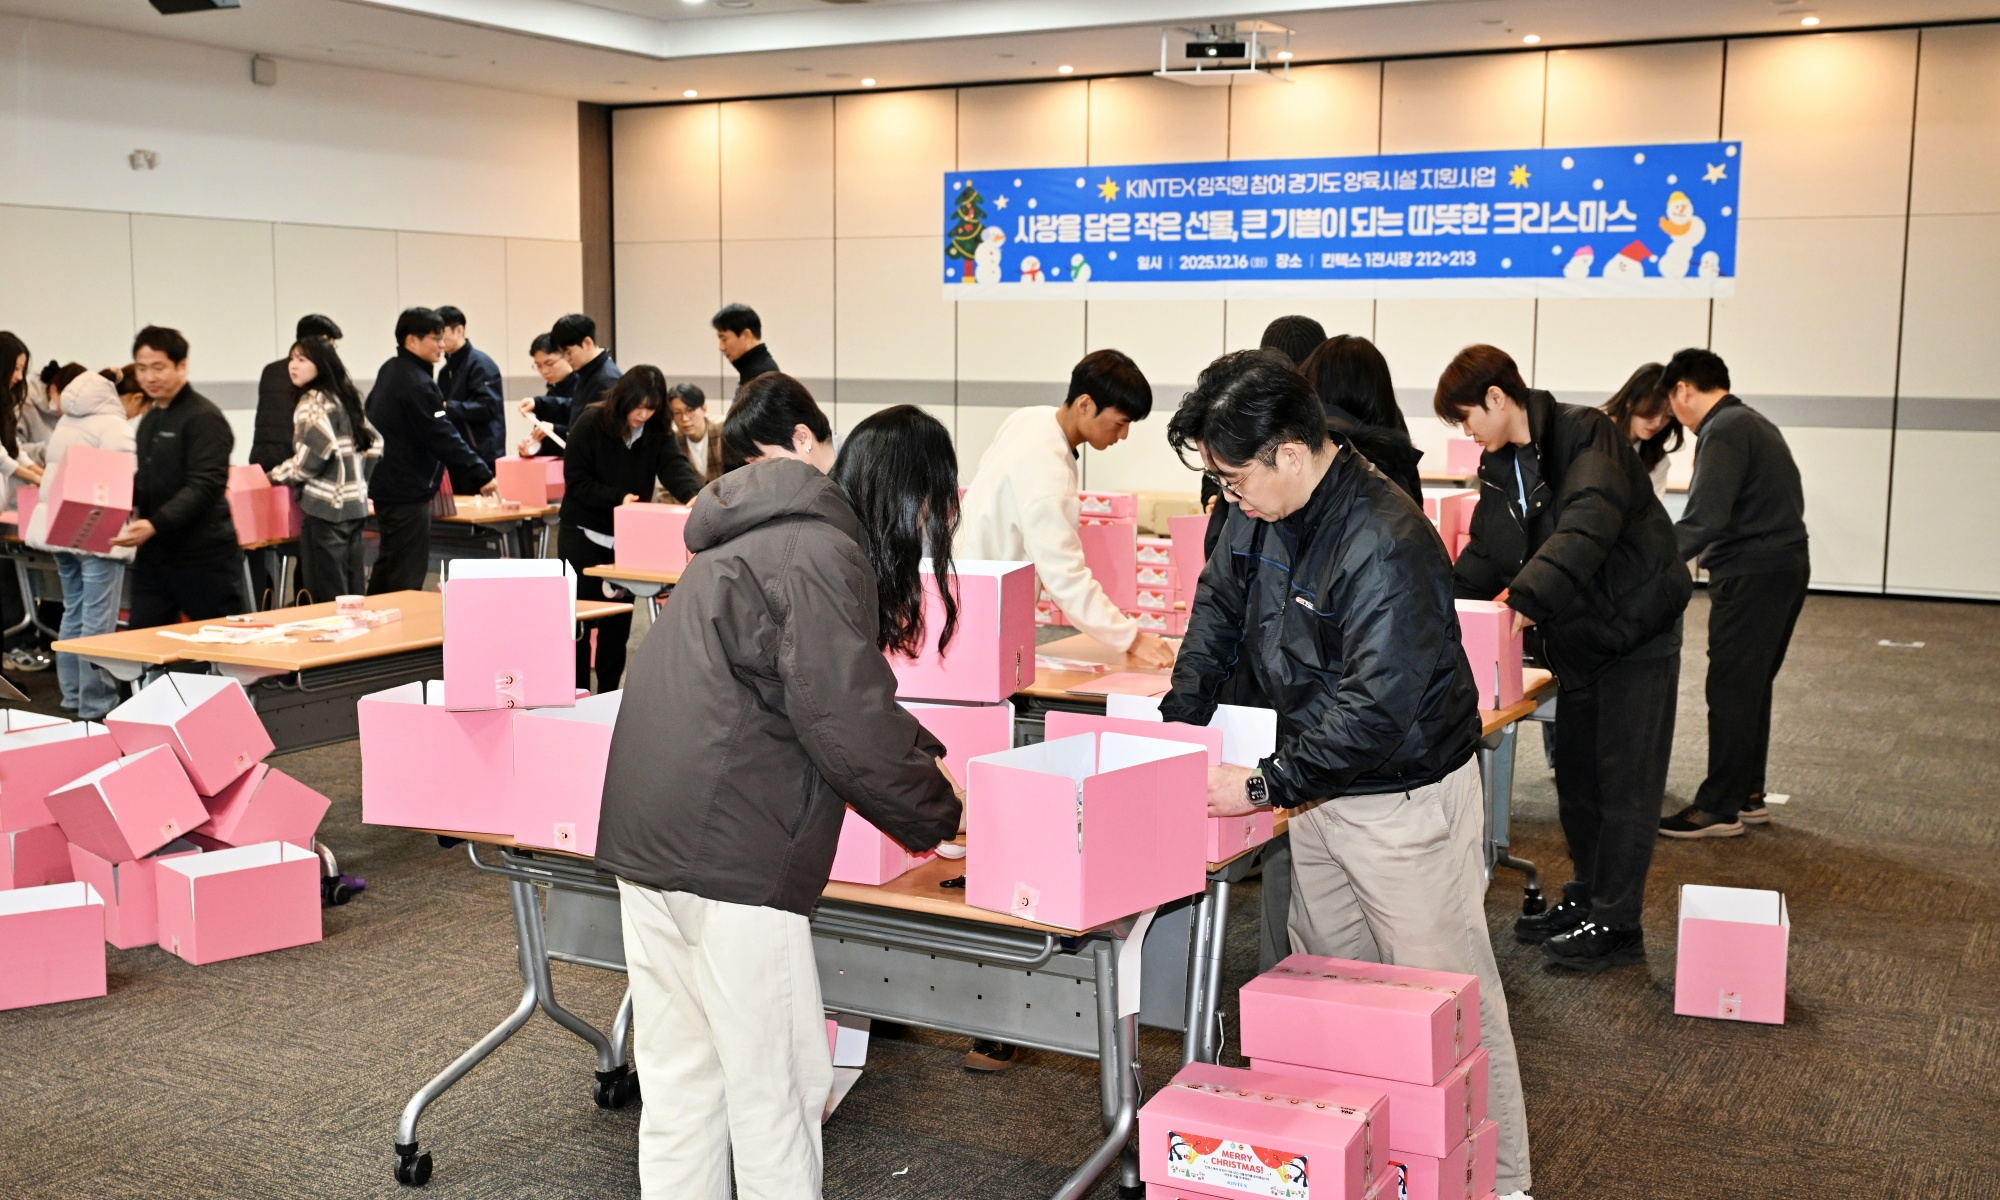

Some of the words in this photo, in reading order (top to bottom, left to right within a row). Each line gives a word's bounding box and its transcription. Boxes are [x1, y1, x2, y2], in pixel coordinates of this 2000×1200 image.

[1126, 178, 1195, 199] KINTEX
[1197, 176, 1248, 197] 임직원
[1251, 174, 1286, 195] 참여
[1288, 172, 1341, 194] 경기도
[1344, 170, 1418, 193] 양육시설
[1420, 166, 1496, 190] 지원사업
[1014, 214, 1081, 244] 사랑을
[1084, 213, 1131, 243] 담은
[1134, 212, 1182, 242] 작은
[1185, 210, 1239, 243] 선물,
[1241, 209, 1268, 240] 큰
[1270, 207, 1347, 239] 기쁨이
[1351, 206, 1404, 238] 되는
[1408, 203, 1491, 236] 따뜻한
[1493, 200, 1637, 235] 크리스마스
[1137, 255, 1163, 271] 일시
[1275, 253, 1303, 269] 장소
[1321, 253, 1363, 269] 킨텍스
[1364, 252, 1414, 268] 1전시장
[1415, 250, 1477, 267] 212+213
[1211, 1157, 1264, 1174] CHRISTMAS!
[1221, 1149, 1253, 1163] MERRY
